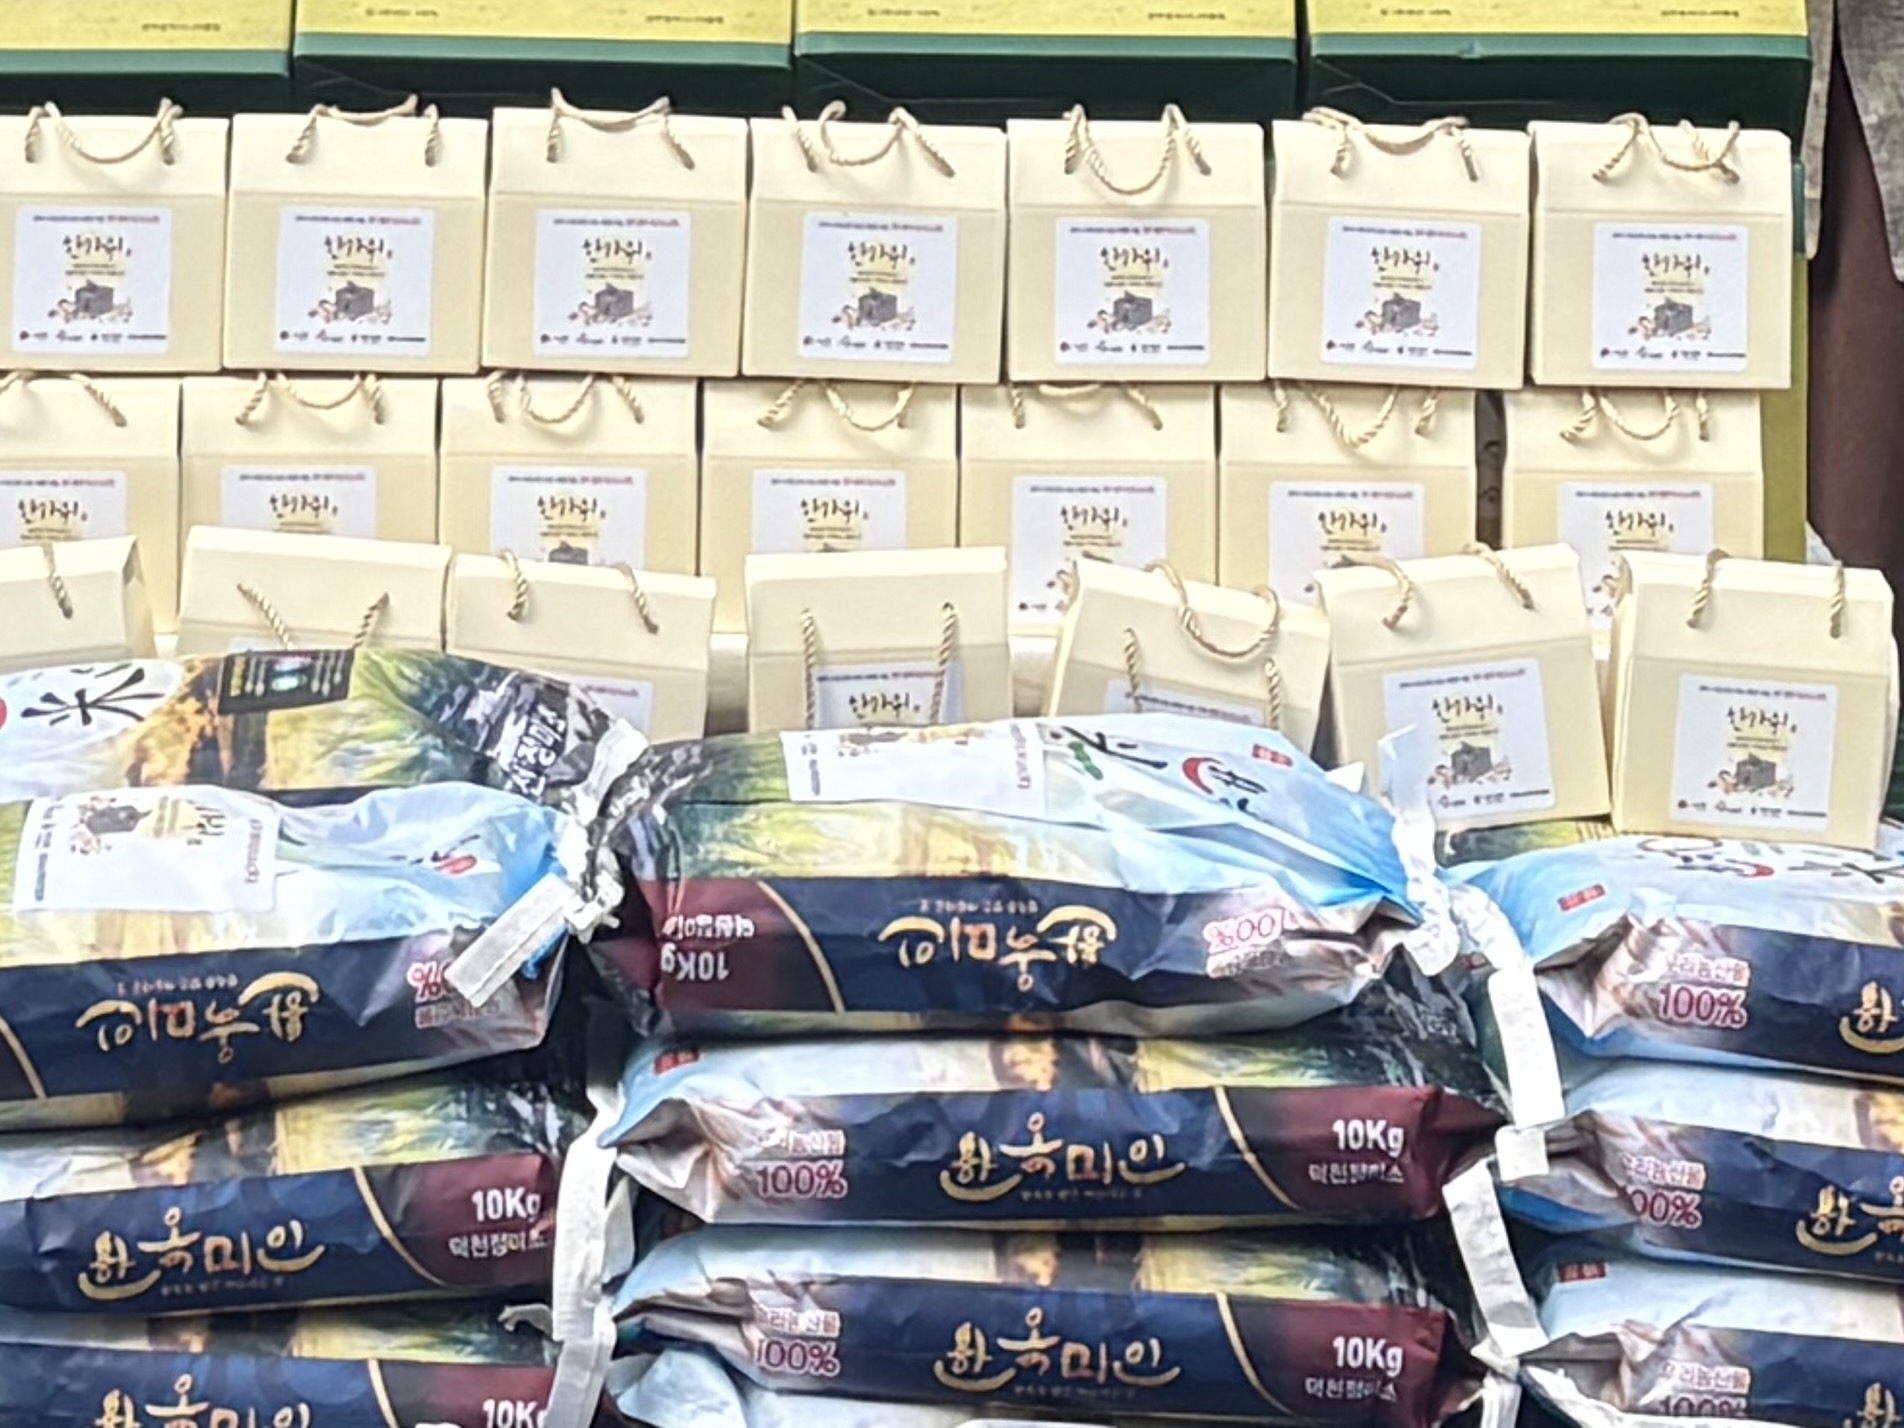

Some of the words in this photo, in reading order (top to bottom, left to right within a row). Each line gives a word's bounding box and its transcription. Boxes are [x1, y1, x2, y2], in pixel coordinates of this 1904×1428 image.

[63, 233, 126, 261] 한가위
[326, 234, 388, 261] 한가위
[582, 239, 642, 268] 한가위
[847, 241, 908, 270] 한가위
[1099, 244, 1162, 272] 한가위
[1370, 245, 1432, 273] 한가위
[1640, 250, 1703, 279] 한가위
[17, 498, 81, 524] 한가위
[269, 491, 330, 518] 한가위
[536, 493, 598, 521] 한가위
[801, 493, 863, 524] 한가위
[1061, 505, 1120, 534] 한가위
[1317, 508, 1378, 538] 한가위
[1605, 508, 1666, 539] 한가위
[848, 691, 911, 722] 한가위
[1432, 695, 1495, 726] 한가위
[1727, 707, 1788, 736] 한가위
[660, 943, 730, 983] 10Kg
[1658, 985, 1748, 1028] 100%
[1333, 1120, 1404, 1156] 10Kg
[756, 1165, 848, 1197] 100%
[471, 1187, 541, 1224] 10Kg
[1333, 1336, 1403, 1377] 10Kg
